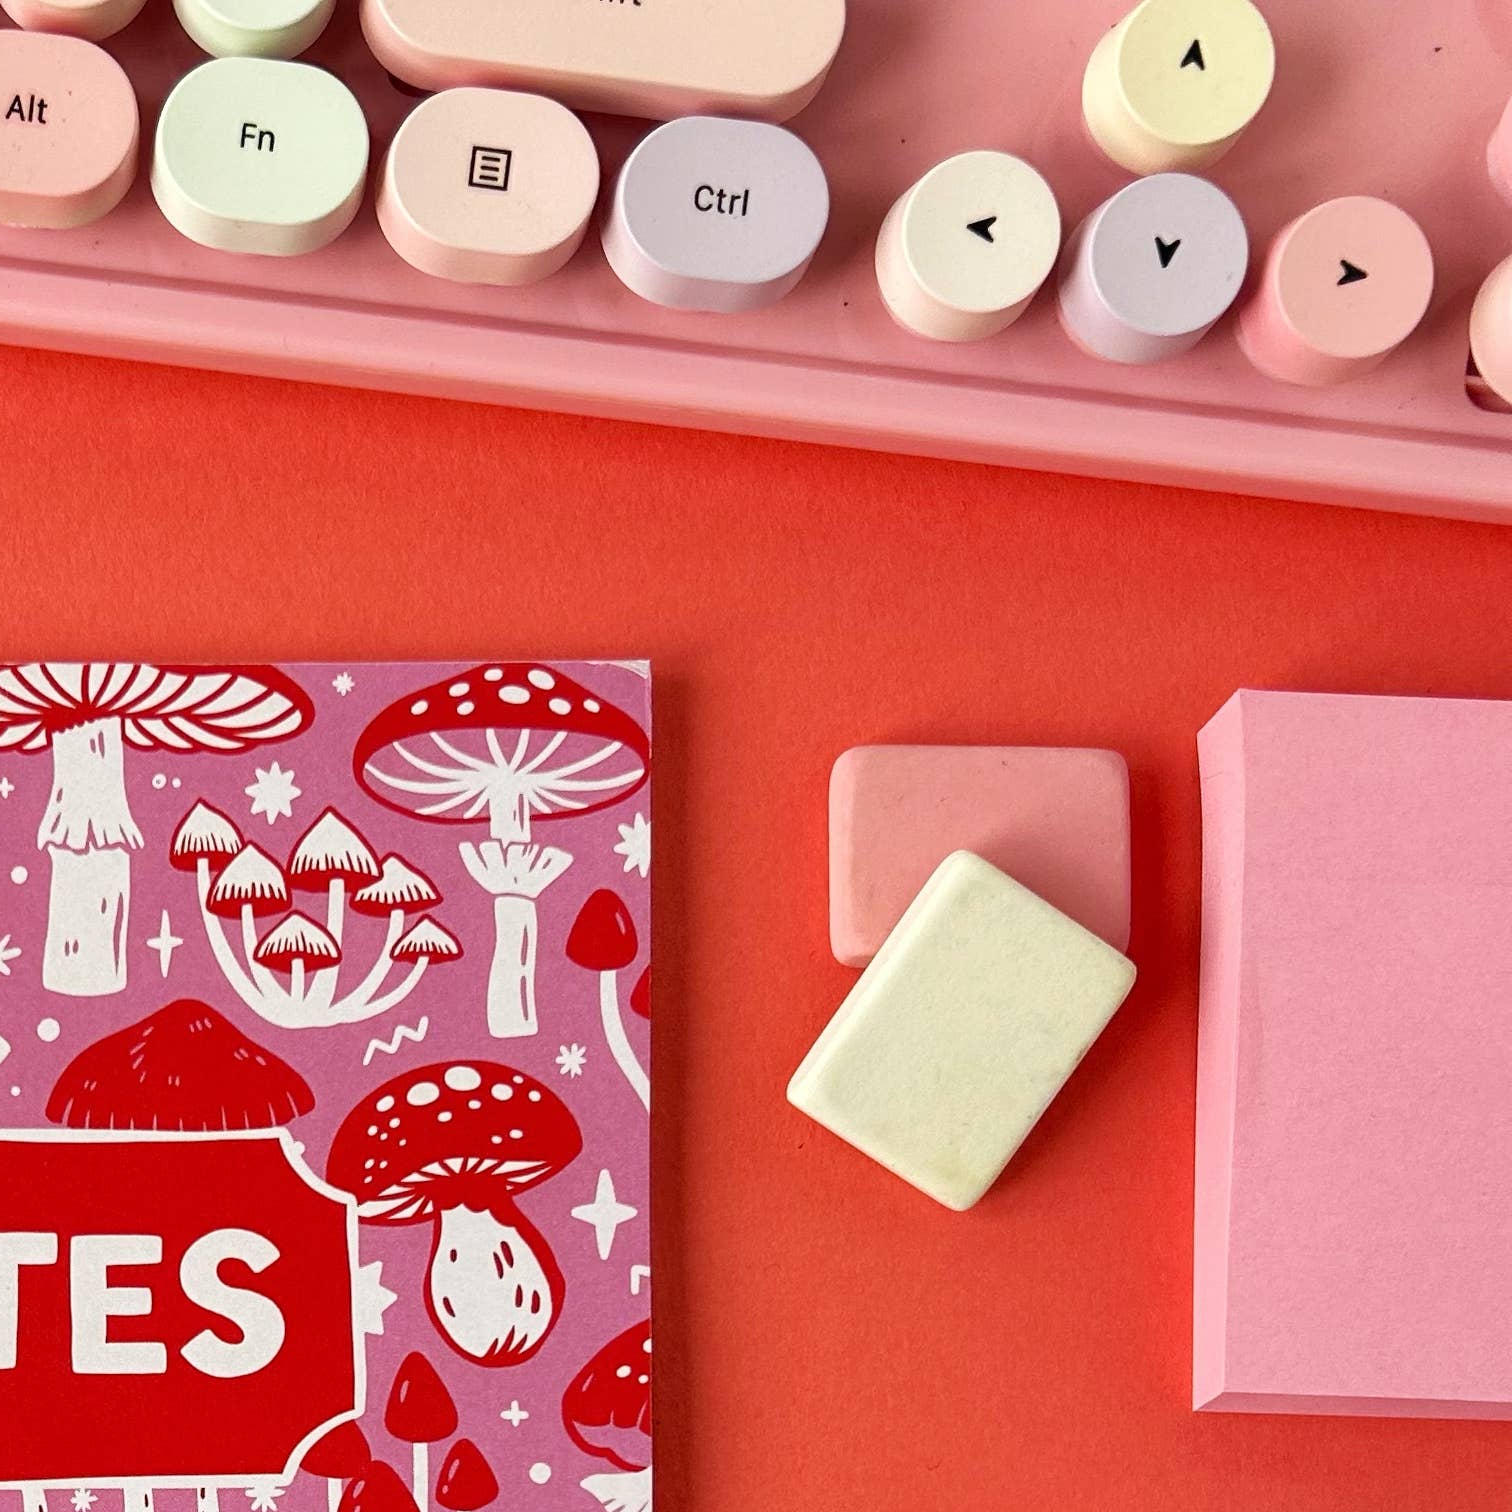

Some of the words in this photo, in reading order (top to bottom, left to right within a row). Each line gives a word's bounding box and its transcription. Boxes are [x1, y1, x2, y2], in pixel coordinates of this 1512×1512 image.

[5, 94, 48, 124] Alt
[240, 122, 275, 152] Fn
[694, 184, 750, 217] Ctrl
